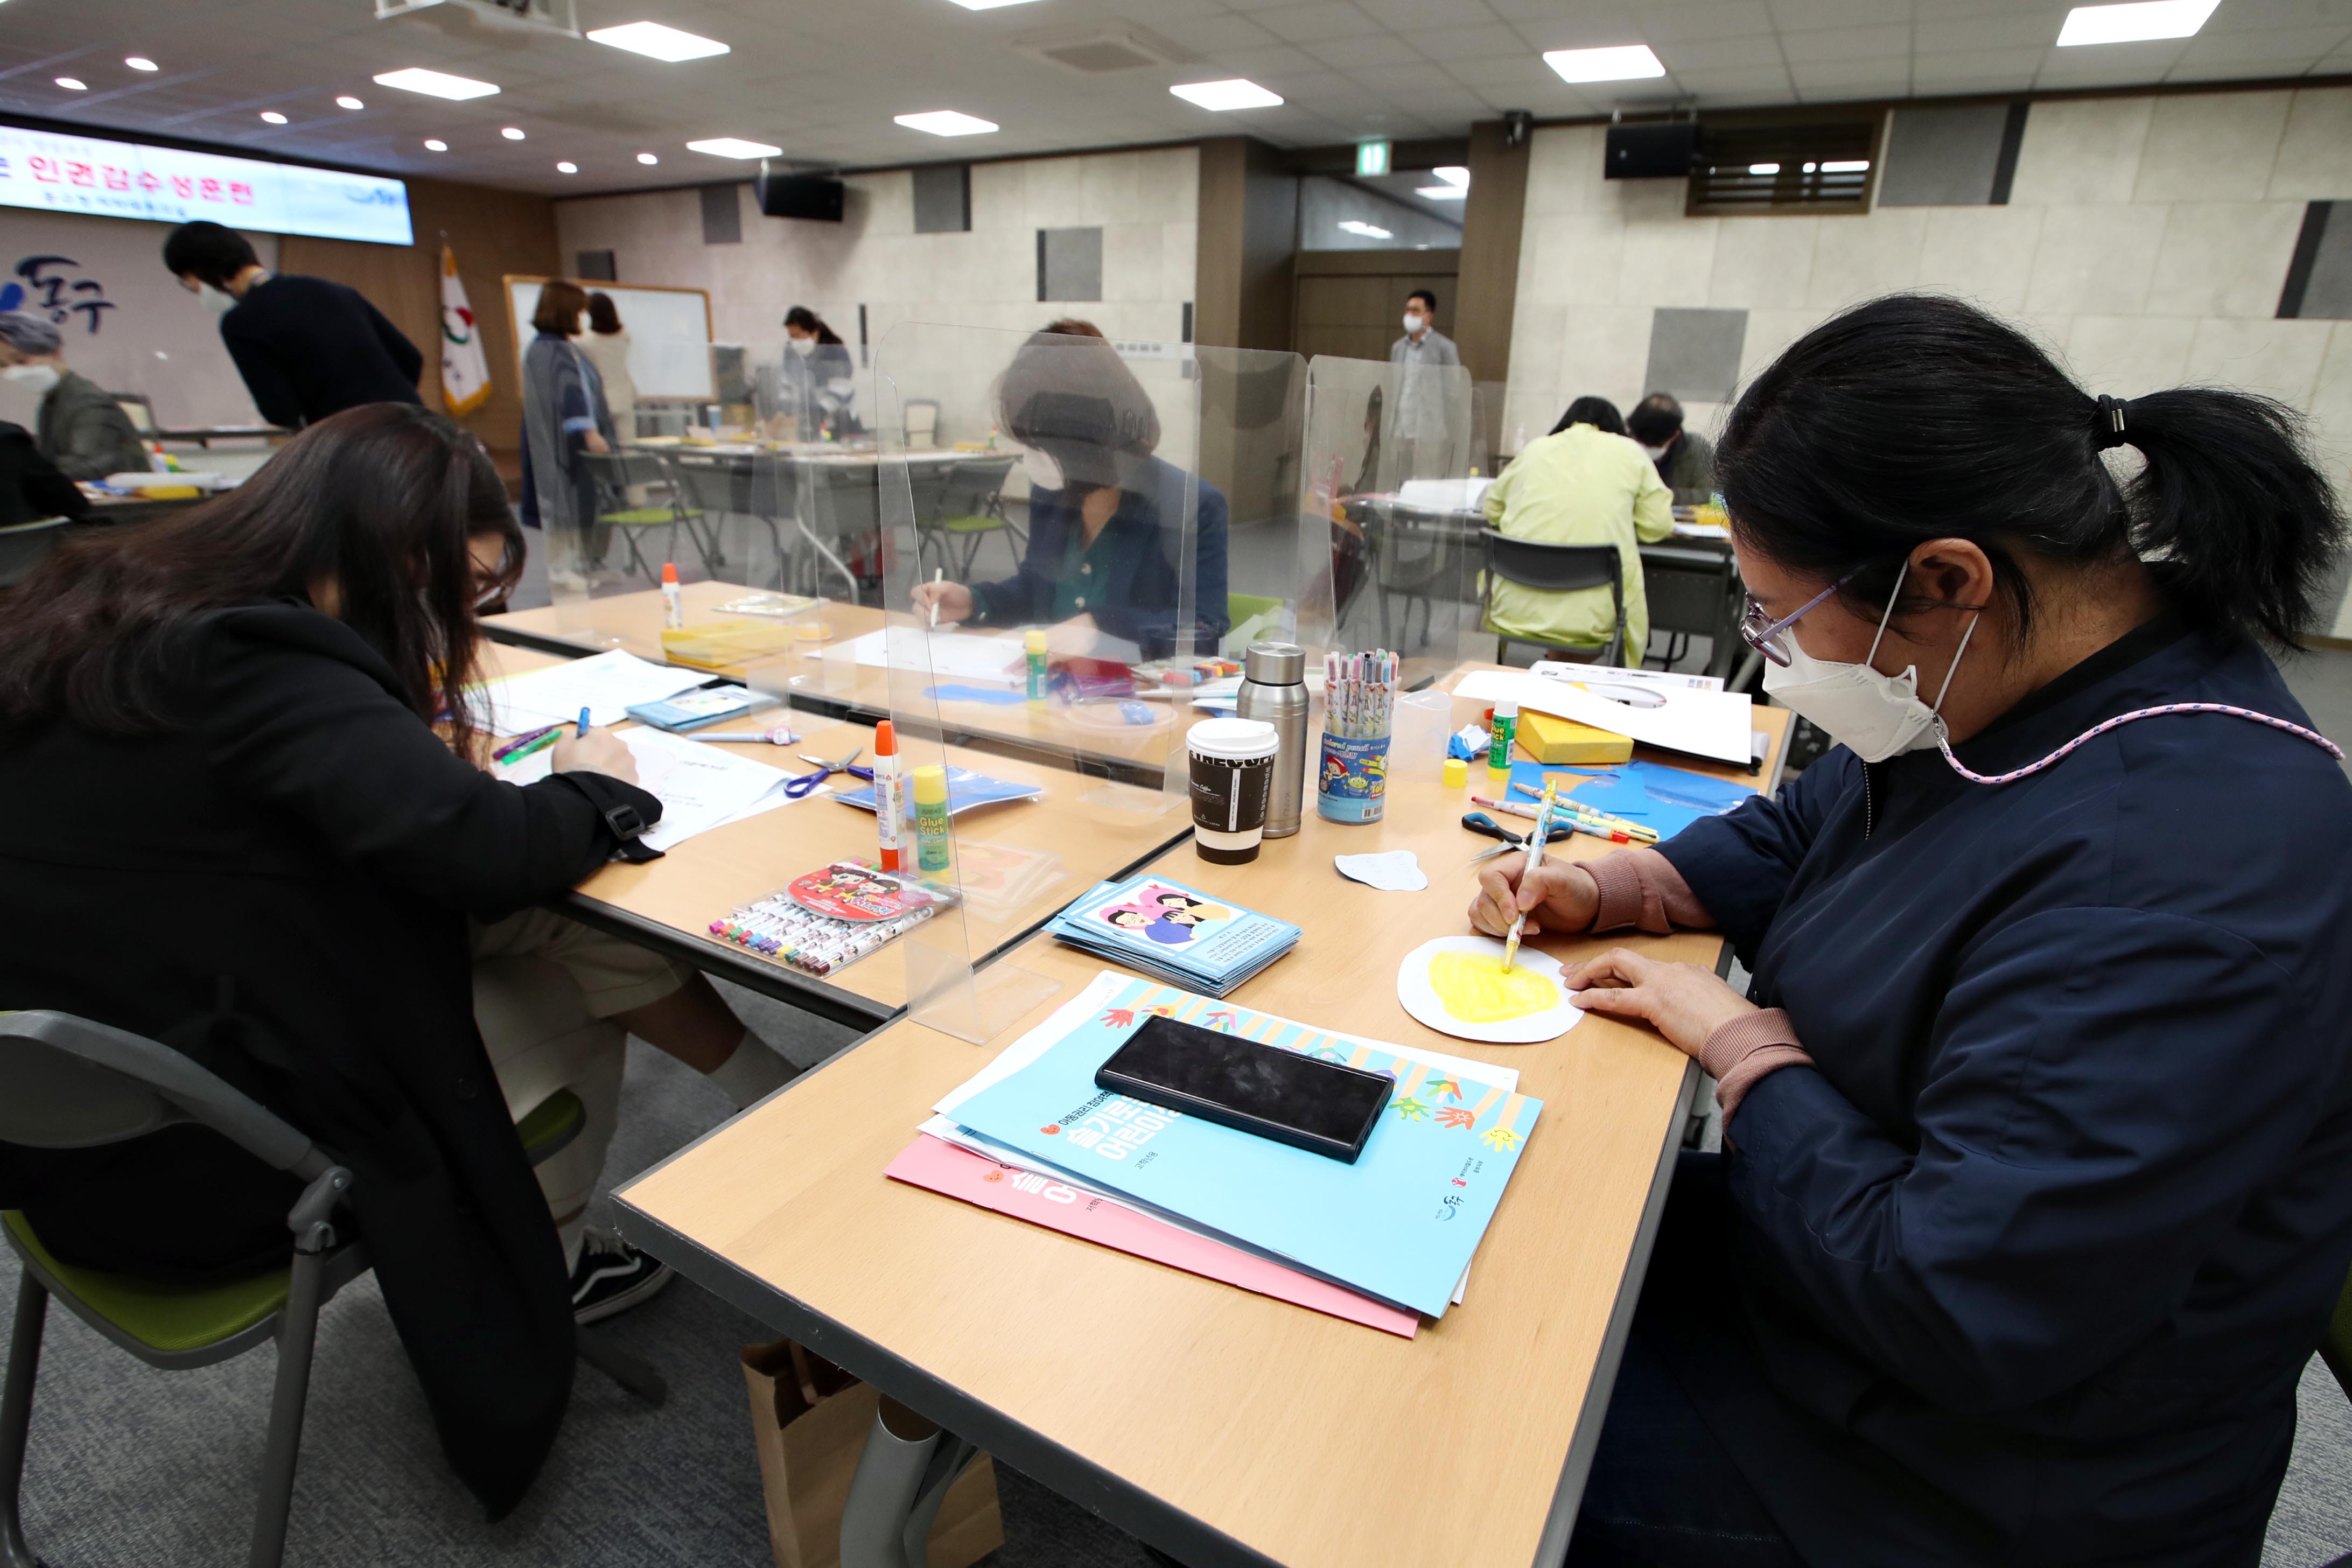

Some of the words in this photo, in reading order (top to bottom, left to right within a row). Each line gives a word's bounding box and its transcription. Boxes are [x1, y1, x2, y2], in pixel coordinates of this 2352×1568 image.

[1346, 744, 1370, 752] pencil
[920, 817, 943, 827] Glue
[920, 825, 944, 836] Stick
[1058, 1105, 1093, 1125] 아동권리
[1134, 1151, 1158, 1170] 고학년용
